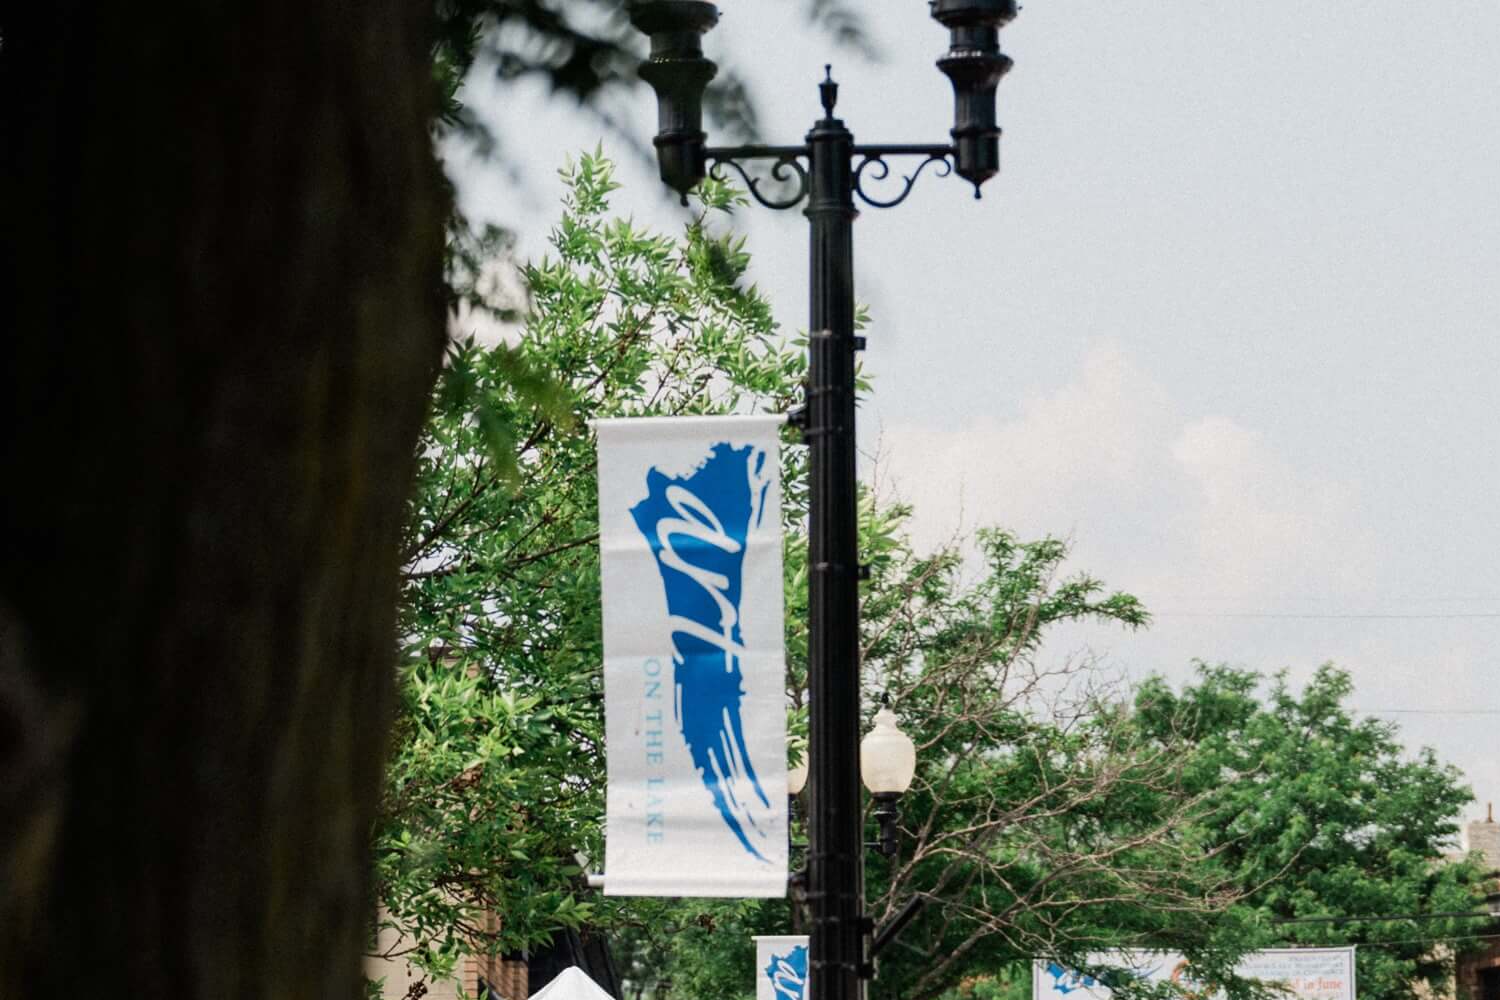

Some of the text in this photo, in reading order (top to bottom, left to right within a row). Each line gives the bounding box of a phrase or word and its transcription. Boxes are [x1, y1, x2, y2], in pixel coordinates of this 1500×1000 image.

[644, 657, 665, 842] ON THE LAKE
